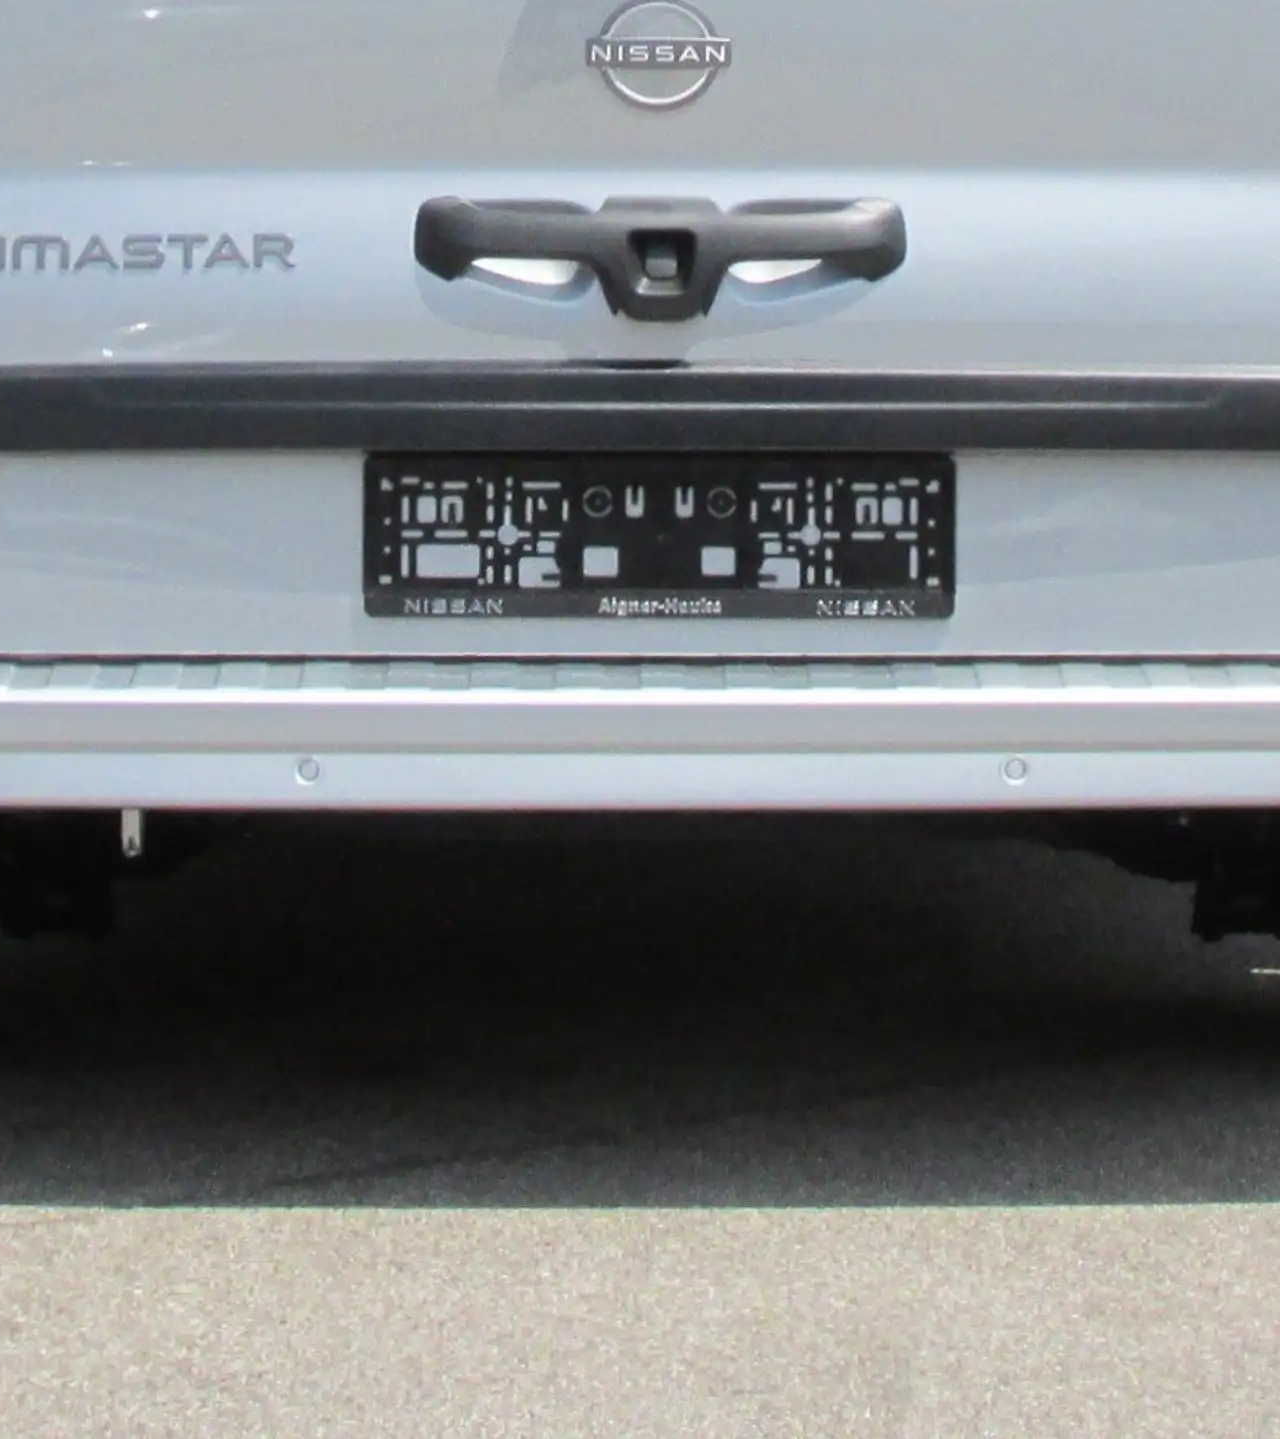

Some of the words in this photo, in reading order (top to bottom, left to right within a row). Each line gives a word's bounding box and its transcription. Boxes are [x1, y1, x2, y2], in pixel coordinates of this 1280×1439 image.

[590, 43, 726, 63] NISSAN
[403, 597, 504, 615] NISSAN
[815, 599, 916, 616] NISSAN
